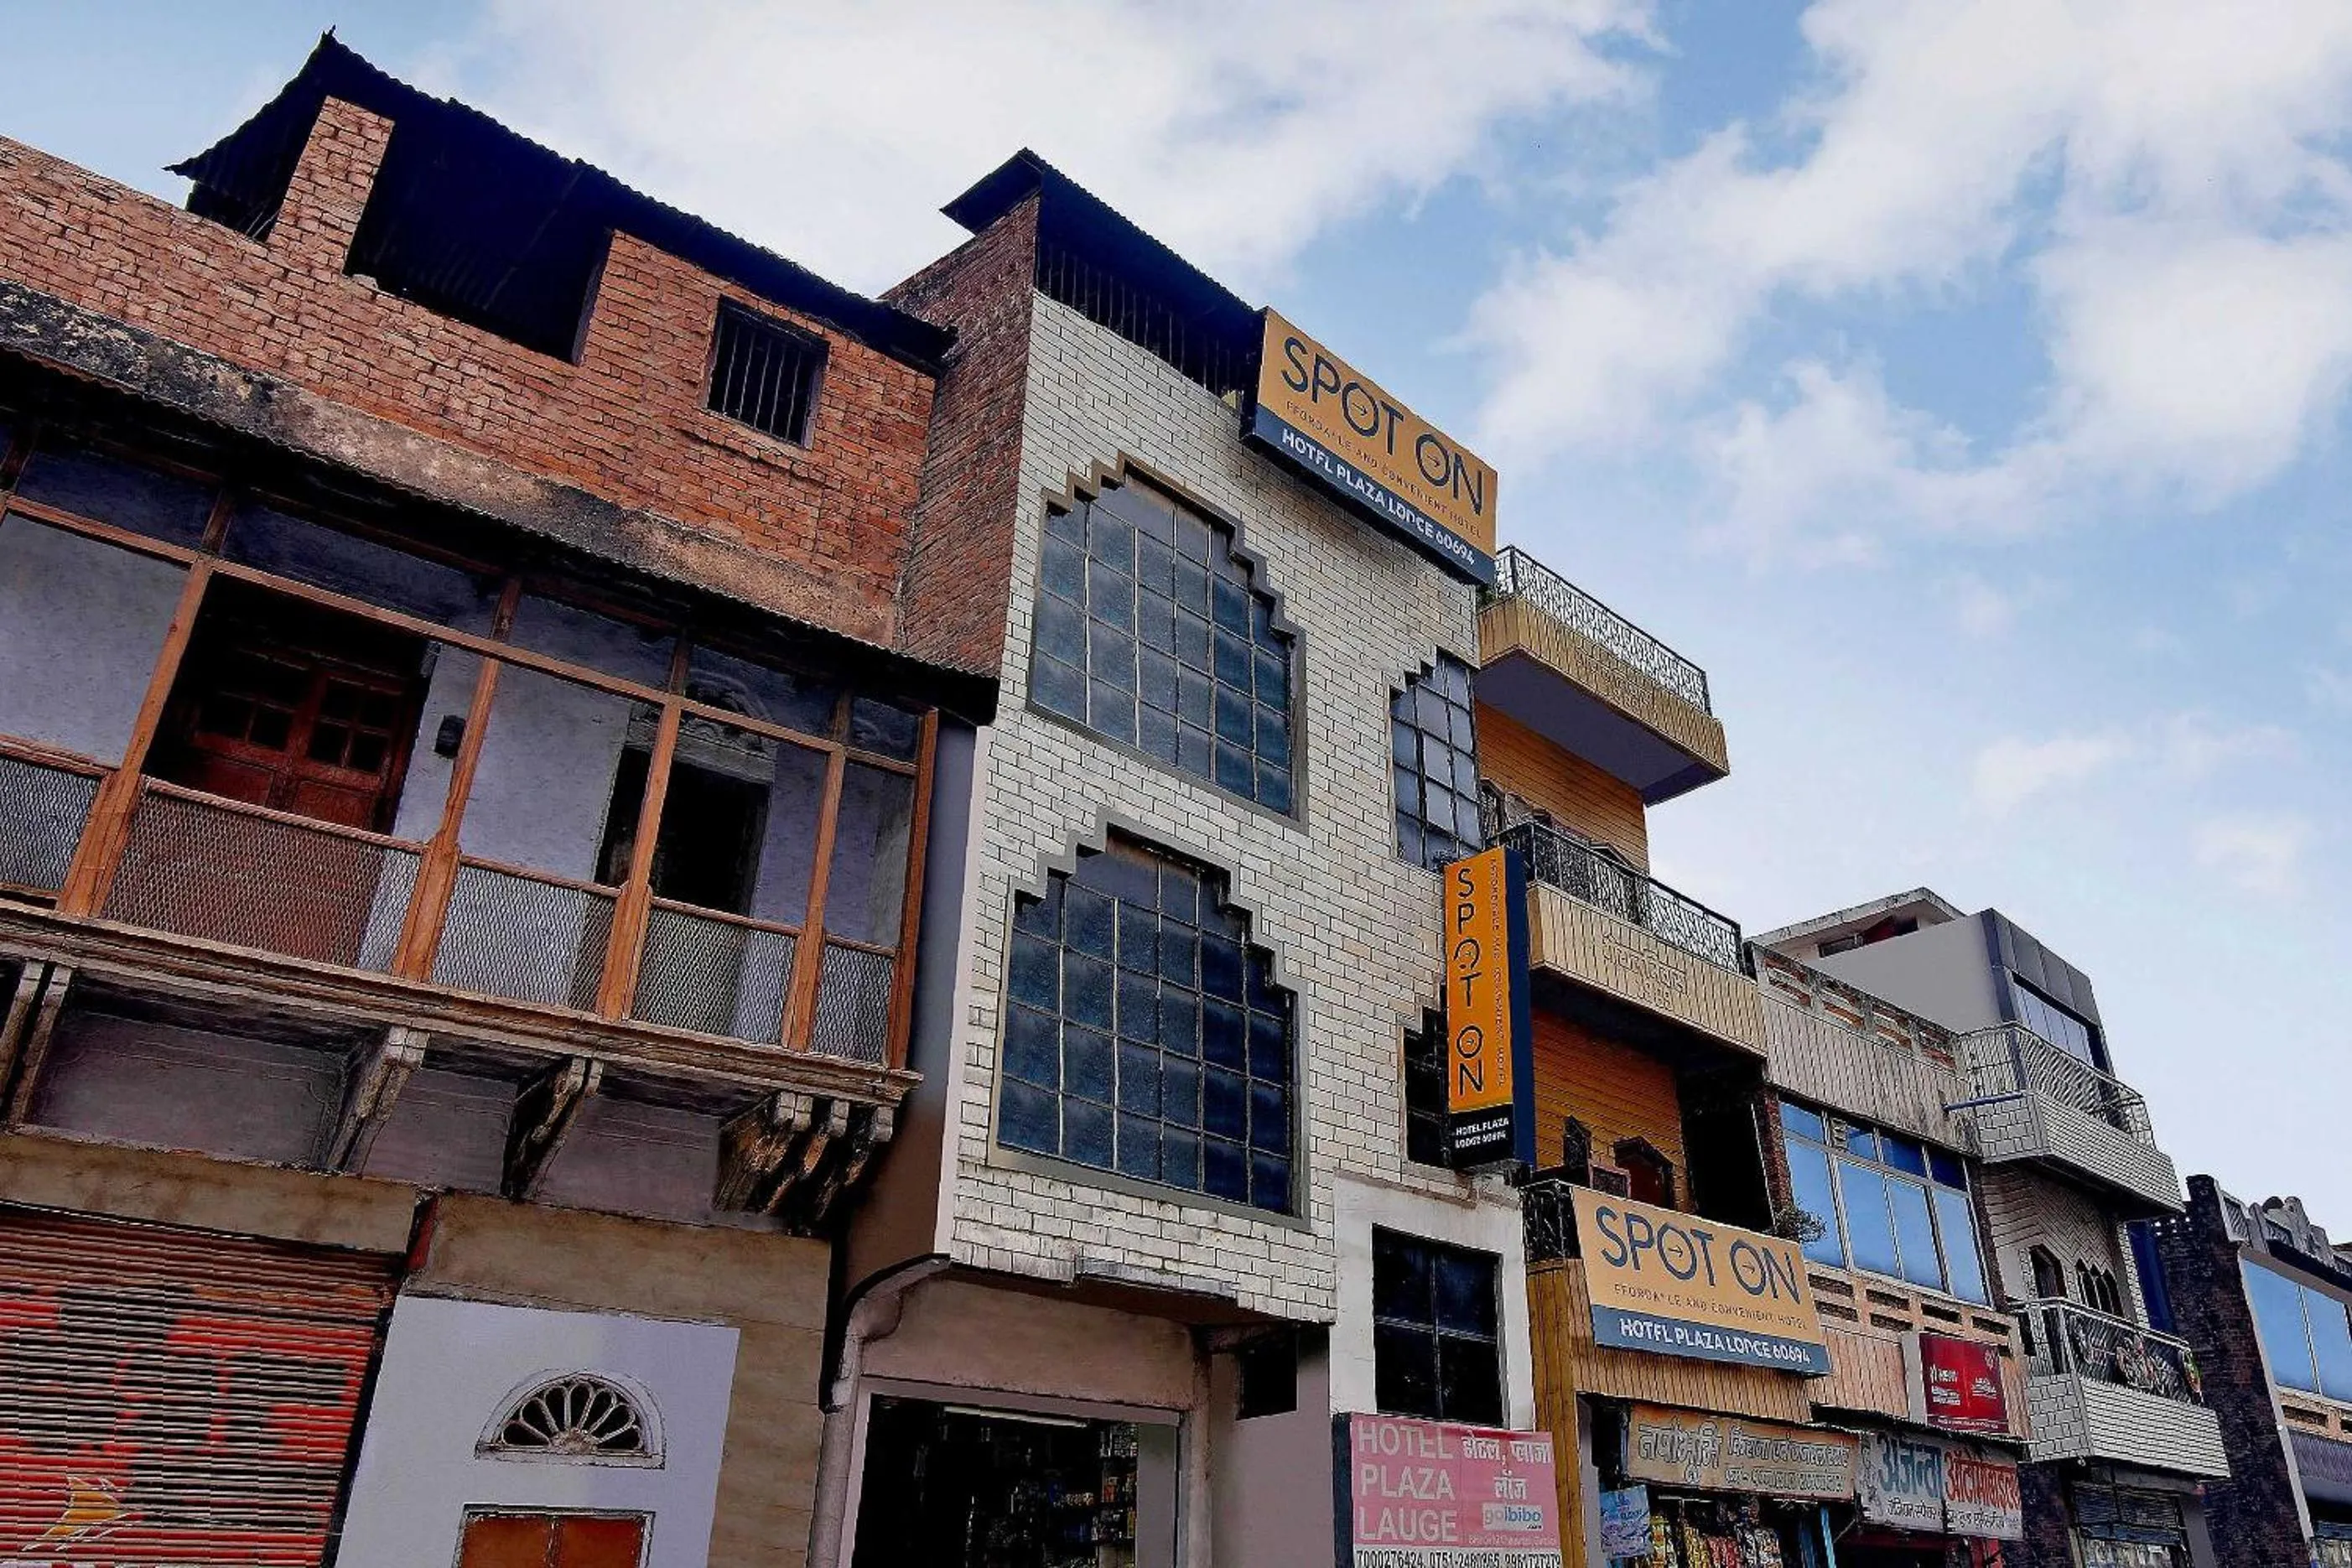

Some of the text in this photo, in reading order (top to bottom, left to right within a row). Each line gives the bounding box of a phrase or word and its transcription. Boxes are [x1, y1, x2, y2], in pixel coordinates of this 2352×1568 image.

[1280, 335, 1484, 517] SPOT ON
[1337, 463, 1385, 508] PLAZA
[1436, 530, 1476, 566] 60694
[1449, 511, 1482, 538] HOTEL
[1453, 867, 1485, 1097] SPOT ON
[1456, 1117, 1509, 1136] HOTEL PLAZA
[1596, 1206, 1802, 1306] SPOT ON
[1686, 1297, 1706, 1311] AND
[1778, 1315, 1807, 1330] HOTEL
[1674, 1327, 1725, 1351] PLAZA
[1773, 1345, 1810, 1364] 60694
[1358, 1421, 1455, 1460] HOTEL
[1360, 1464, 1456, 1501] PLAZA
[1359, 1506, 1457, 1543] LAUGE
[1485, 1507, 1541, 1525] goibibo
